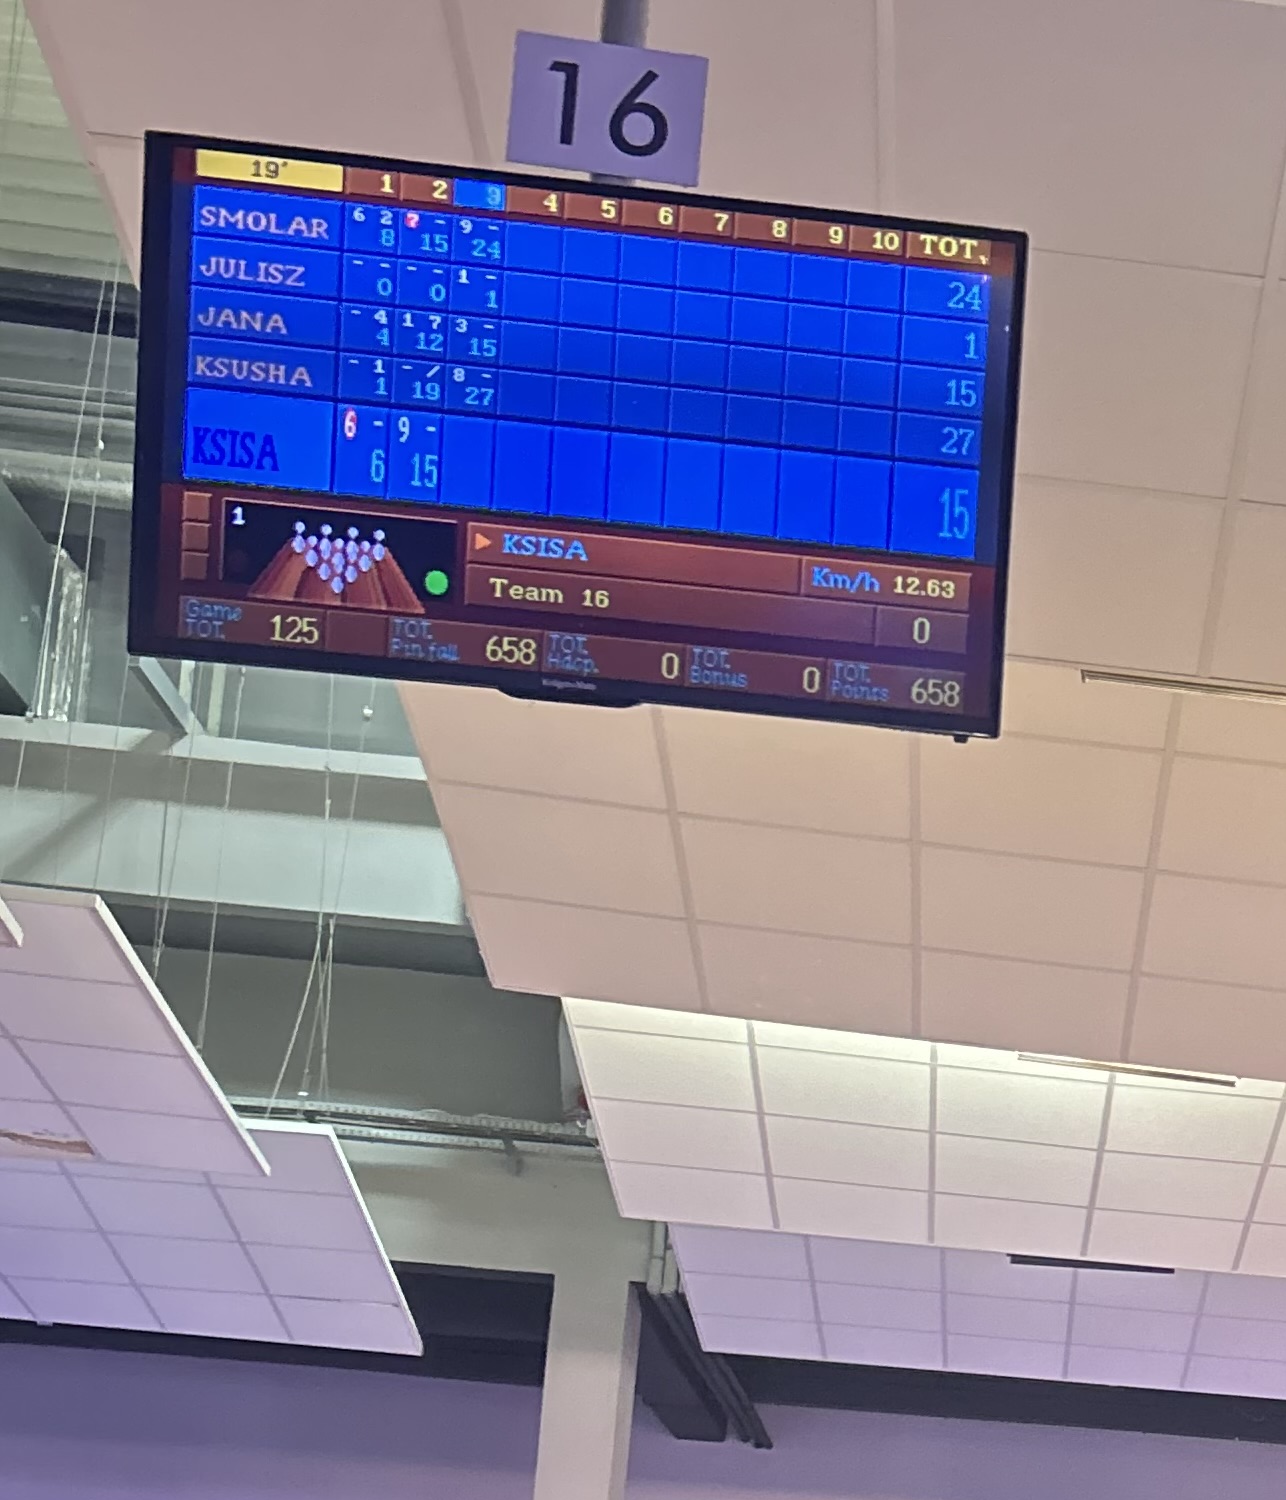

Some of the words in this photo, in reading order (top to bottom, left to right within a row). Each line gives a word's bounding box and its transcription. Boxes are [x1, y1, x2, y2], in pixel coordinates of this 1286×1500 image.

[547, 60, 668, 157] 16
[380, 173, 395, 194] 1
[432, 179, 448, 200] 2
[543, 192, 559, 213] 4
[600, 199, 616, 220] 5
[657, 206, 674, 227] 6
[714, 212, 730, 233] 7
[771, 219, 787, 240] 8
[828, 225, 844, 246] 9
[872, 231, 899, 252] 10
[199, 205, 330, 240] SMOLAR
[352, 206, 366, 223] 6
[379, 209, 394, 226] 2
[459, 218, 473, 234] 9
[947, 280, 983, 312] 24
[380, 228, 395, 247] 8
[419, 232, 449, 254] 15
[471, 238, 501, 260] 24
[199, 253, 306, 288] JULISZ
[458, 268, 470, 284] 1
[963, 330, 980, 360] 1
[376, 277, 393, 297] 0
[429, 283, 446, 302] 0
[485, 289, 498, 309] 1
[197, 304, 288, 336] JANA
[373, 309, 388, 325] 4
[402, 312, 414, 328] 1
[454, 317, 468, 333] 3
[944, 379, 977, 408] 15
[375, 327, 390, 347] 4
[415, 332, 444, 352] 12
[468, 337, 498, 357] 15
[194, 353, 313, 389] KSUSHA
[373, 358, 386, 375] 1
[452, 367, 466, 383] 8
[940, 425, 975, 456] 27
[375, 376, 389, 396] 1
[412, 380, 441, 401] 19
[464, 386, 495, 406] 27
[192, 426, 281, 473] KSISA
[398, 415, 411, 443] 9
[938, 486, 970, 540] 15
[370, 448, 386, 483] 6
[410, 452, 439, 488] 15
[231, 506, 246, 526] 1
[502, 532, 589, 562] KSISA
[811, 566, 881, 594] Km/h
[893, 575, 956, 600] 12.63
[185, 600, 243, 621] Game
[489, 577, 565, 605] Team
[581, 588, 610, 609] 16
[911, 616, 931, 645] 0
[269, 614, 319, 645] 125
[485, 634, 538, 666] 658
[660, 651, 681, 681] 0
[802, 665, 822, 694] 0
[910, 677, 961, 708] 658
